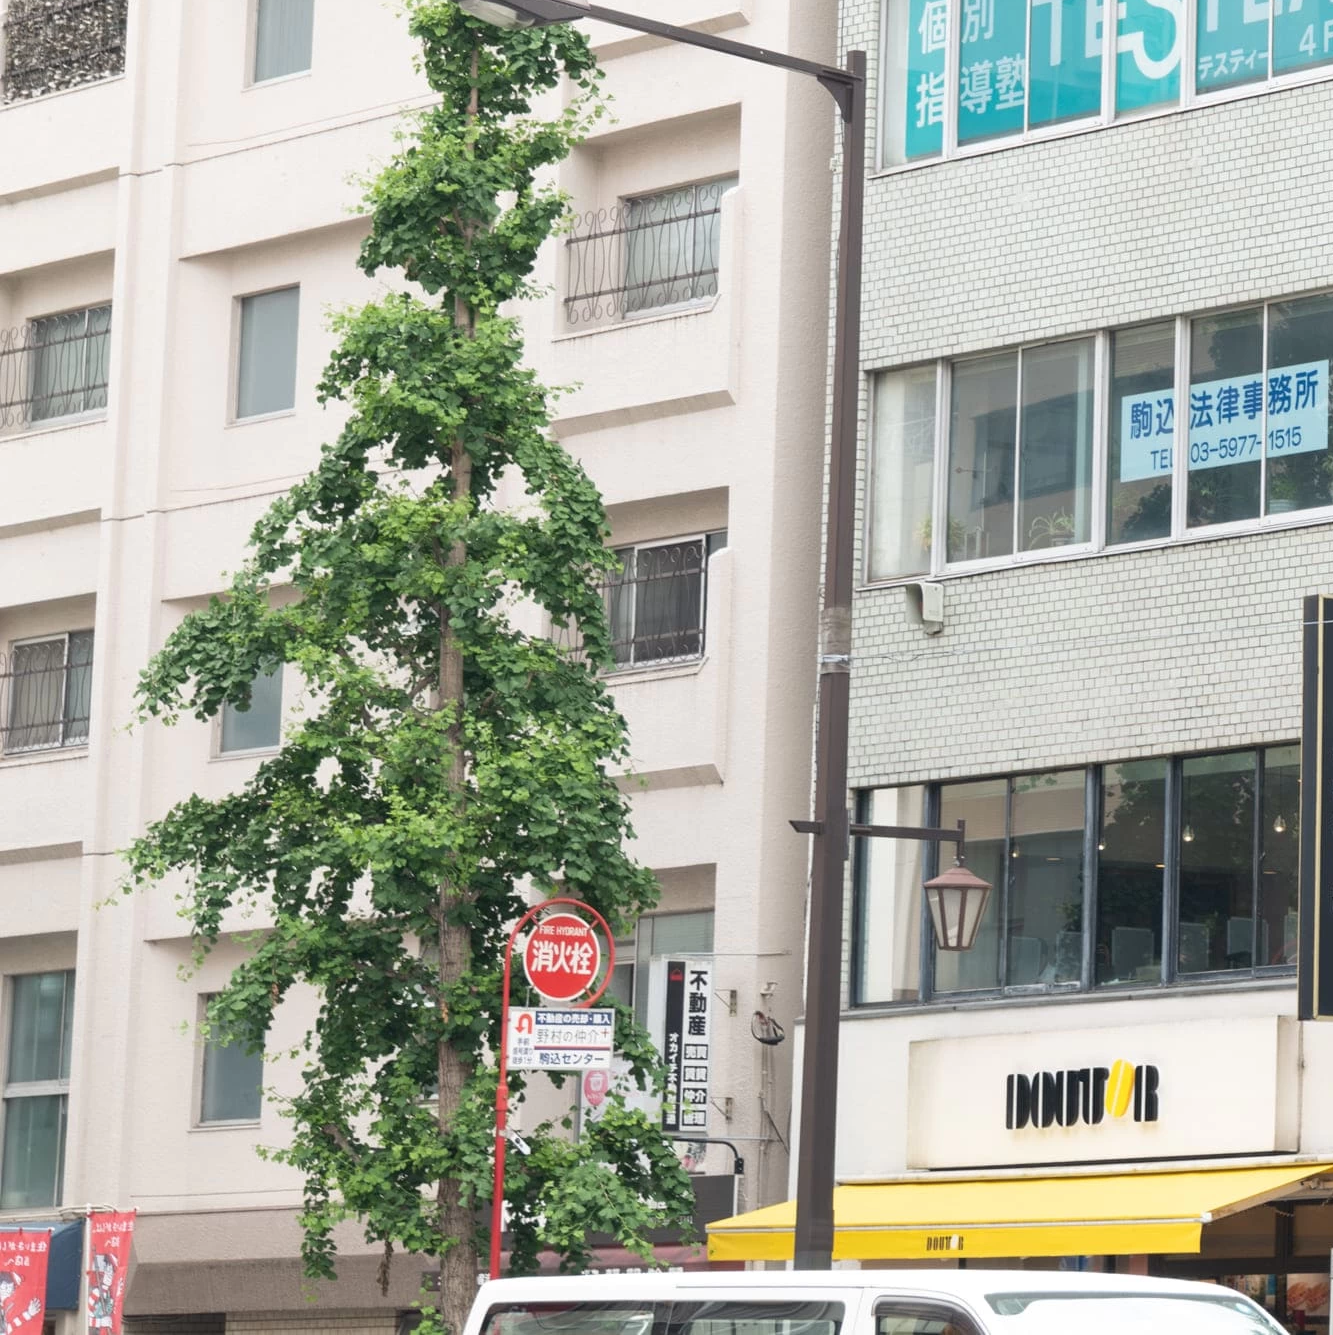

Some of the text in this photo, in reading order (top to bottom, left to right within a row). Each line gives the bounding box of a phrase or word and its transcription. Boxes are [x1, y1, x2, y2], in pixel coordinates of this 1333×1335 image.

[1197, 46, 1270, 81] テスティー
[916, 54, 1027, 129] 指導塾
[1130, 369, 1319, 440] 駒込法律事務所
[1190, 426, 1302, 463] 03-5977-1515
[539, 925, 588, 937] FIRE HYDRANT
[531, 939, 594, 975] 消火栓
[688, 970, 708, 1036] 不動産
[539, 1053, 604, 1065] 駒込センター
[684, 1089, 706, 1103] 仲介
[1005, 1058, 1160, 1131] DOUTOR
[926, 1233, 964, 1251] DOUTOR
